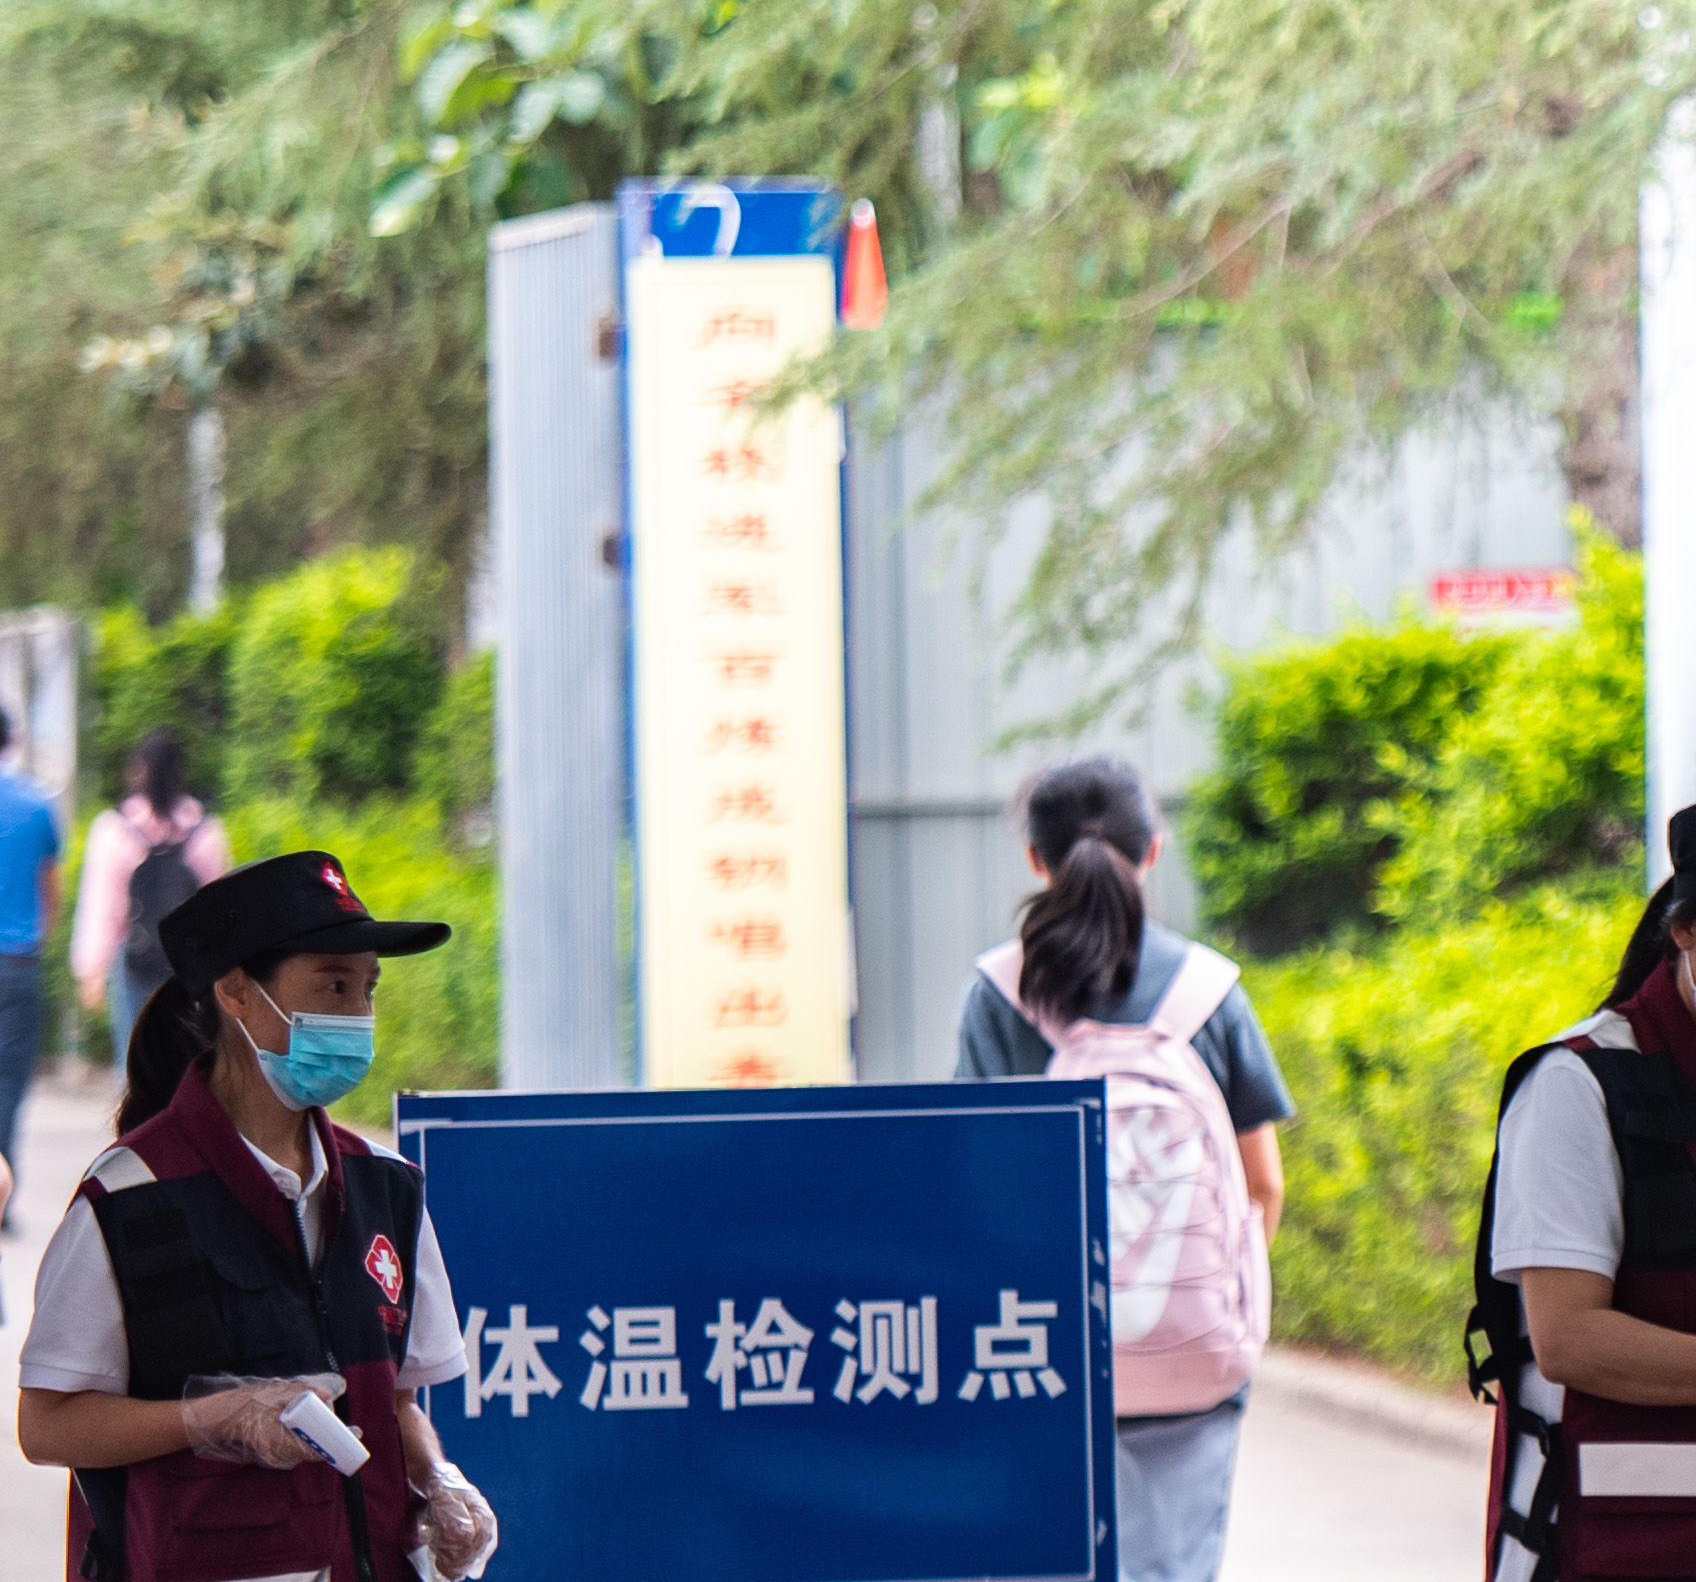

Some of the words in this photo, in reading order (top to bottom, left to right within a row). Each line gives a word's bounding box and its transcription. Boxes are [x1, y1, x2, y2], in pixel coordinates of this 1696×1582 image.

[464, 1289, 1068, 1419] 体温检测点
